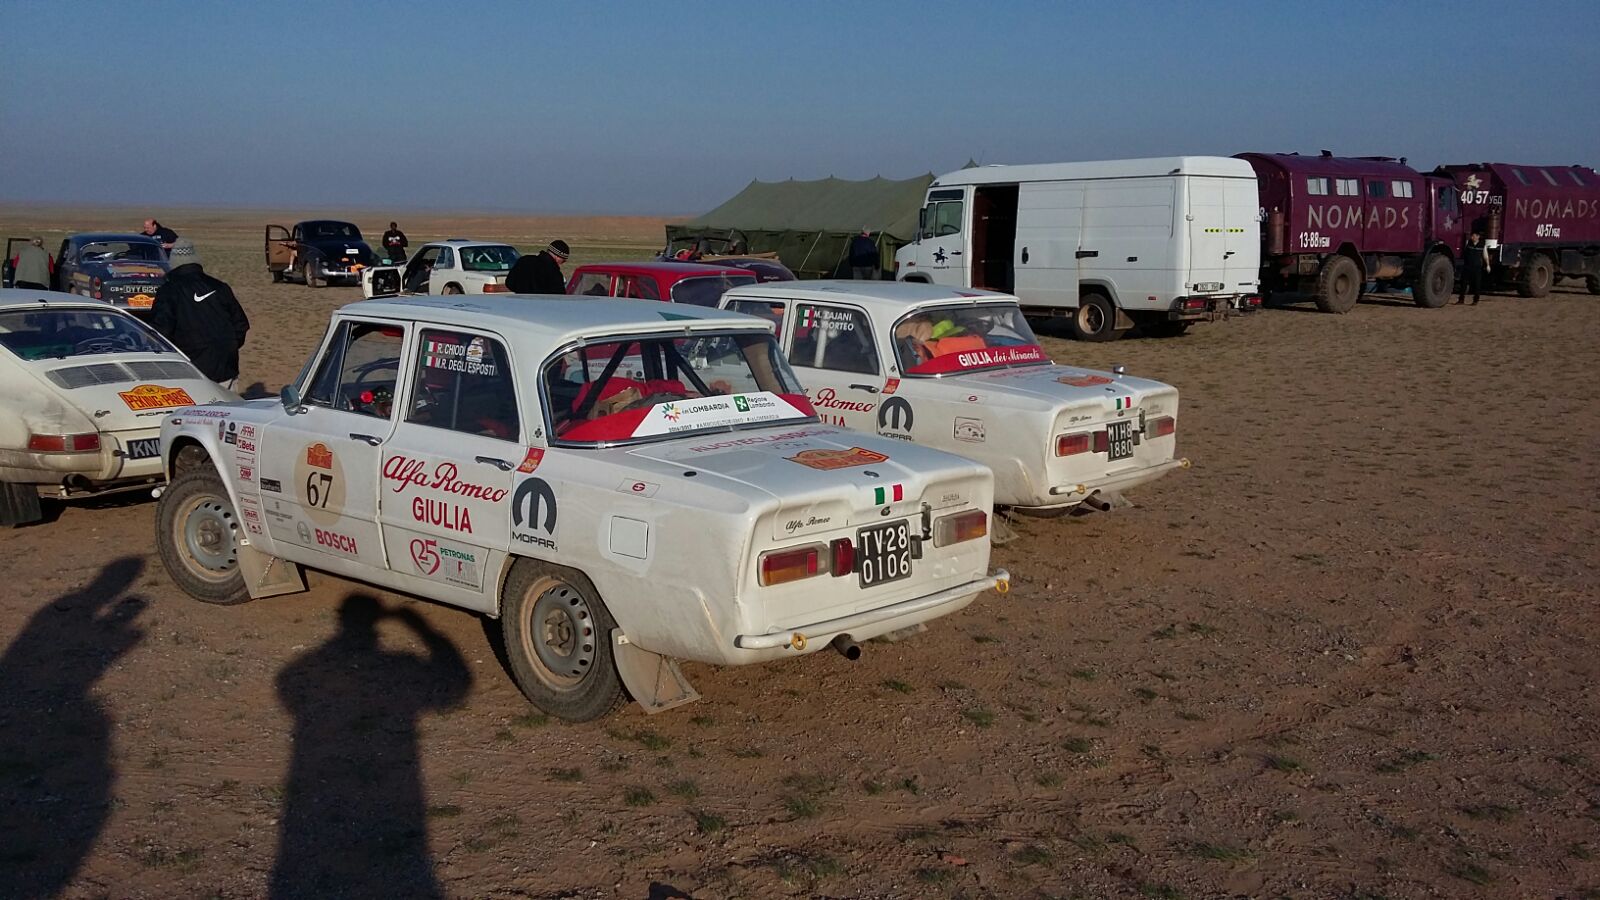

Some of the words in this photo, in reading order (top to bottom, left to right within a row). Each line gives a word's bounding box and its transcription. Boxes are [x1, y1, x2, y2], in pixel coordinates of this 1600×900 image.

[1461, 191, 1473, 204] 40
[1475, 190, 1489, 204] 57
[1307, 204, 1409, 229] NOMADS
[1515, 198, 1598, 219] NOMADS
[437, 343, 444, 354] R.
[958, 351, 993, 367] GIULIA
[993, 350, 1007, 363] dei
[448, 359, 467, 373] DEGLI
[467, 362, 495, 377] ESPOSTI
[814, 388, 876, 413] Romeo
[1107, 423, 1132, 441] MIH8
[241, 440, 255, 452] Beta
[1109, 439, 1133, 458] 1880
[383, 455, 431, 493] Alfa
[430, 462, 509, 503] Romeo
[306, 471, 333, 509] 67
[412, 496, 473, 534] GIULIA
[785, 519, 804, 534] Alfa
[805, 516, 831, 526] Romeo
[315, 528, 358, 555] BOSCH
[512, 531, 555, 551] MOPAR
[860, 525, 908, 557] TV28
[440, 547, 476, 563] PETRONAS
[863, 550, 909, 584] 0106
